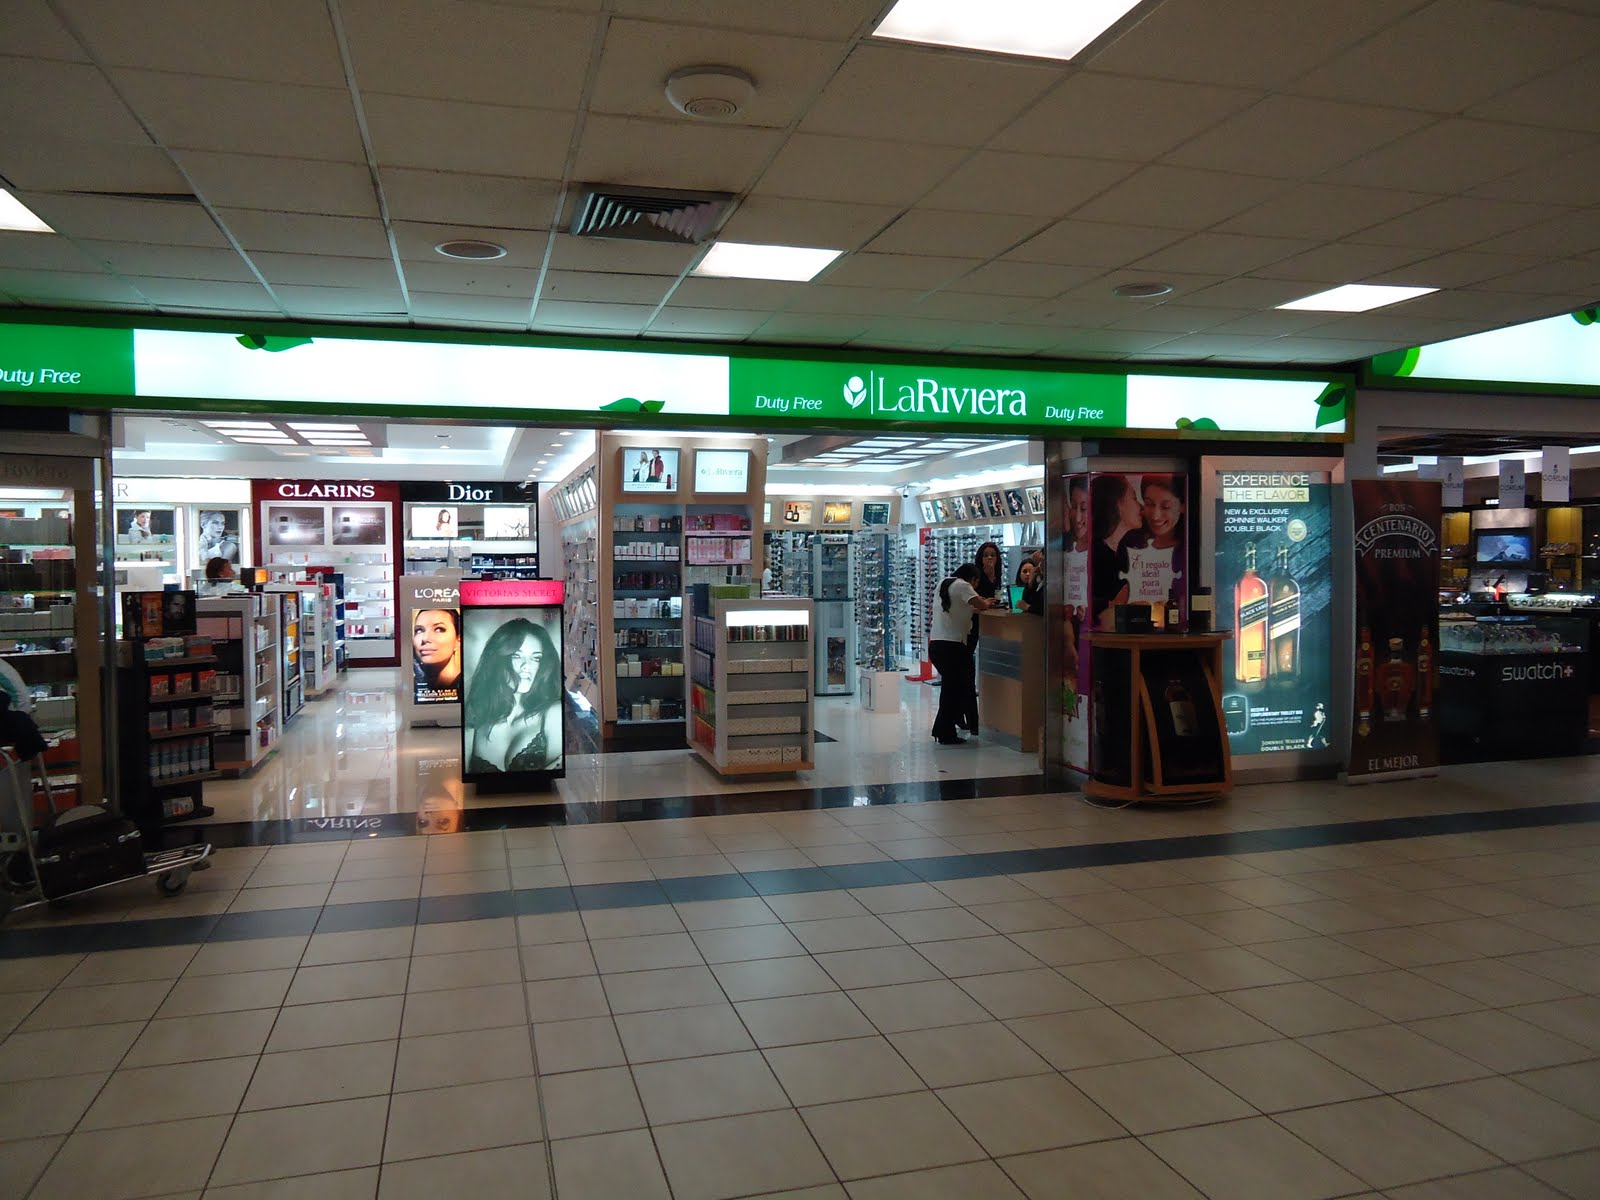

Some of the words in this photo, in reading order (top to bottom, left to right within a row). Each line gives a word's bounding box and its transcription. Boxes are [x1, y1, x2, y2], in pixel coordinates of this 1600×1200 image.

[0, 368, 34, 386] uty
[39, 368, 81, 384] Free
[755, 395, 789, 412] Duty
[793, 397, 822, 411] Free
[1045, 406, 1075, 421] Duty
[1078, 407, 1104, 420] Free
[1223, 475, 1309, 486] EXPERIENCE
[278, 484, 375, 498] CLARINS
[447, 484, 494, 501] Dior
[1227, 490, 1252, 500] THE
[1256, 489, 1305, 500] FLAVOR
[1224, 508, 1241, 516] NEW
[1363, 519, 1430, 541] CENTENARIO
[1375, 548, 1421, 558] PREMIUM
[1145, 560, 1170, 570] regalo
[1142, 580, 1160, 588] para
[415, 587, 460, 598] L'ORÉA
[465, 589, 519, 598] VICTORIA'S
[522, 589, 557, 598] SECRET
[1368, 758, 1380, 771] EL
[1383, 755, 1420, 769] MEJOR
